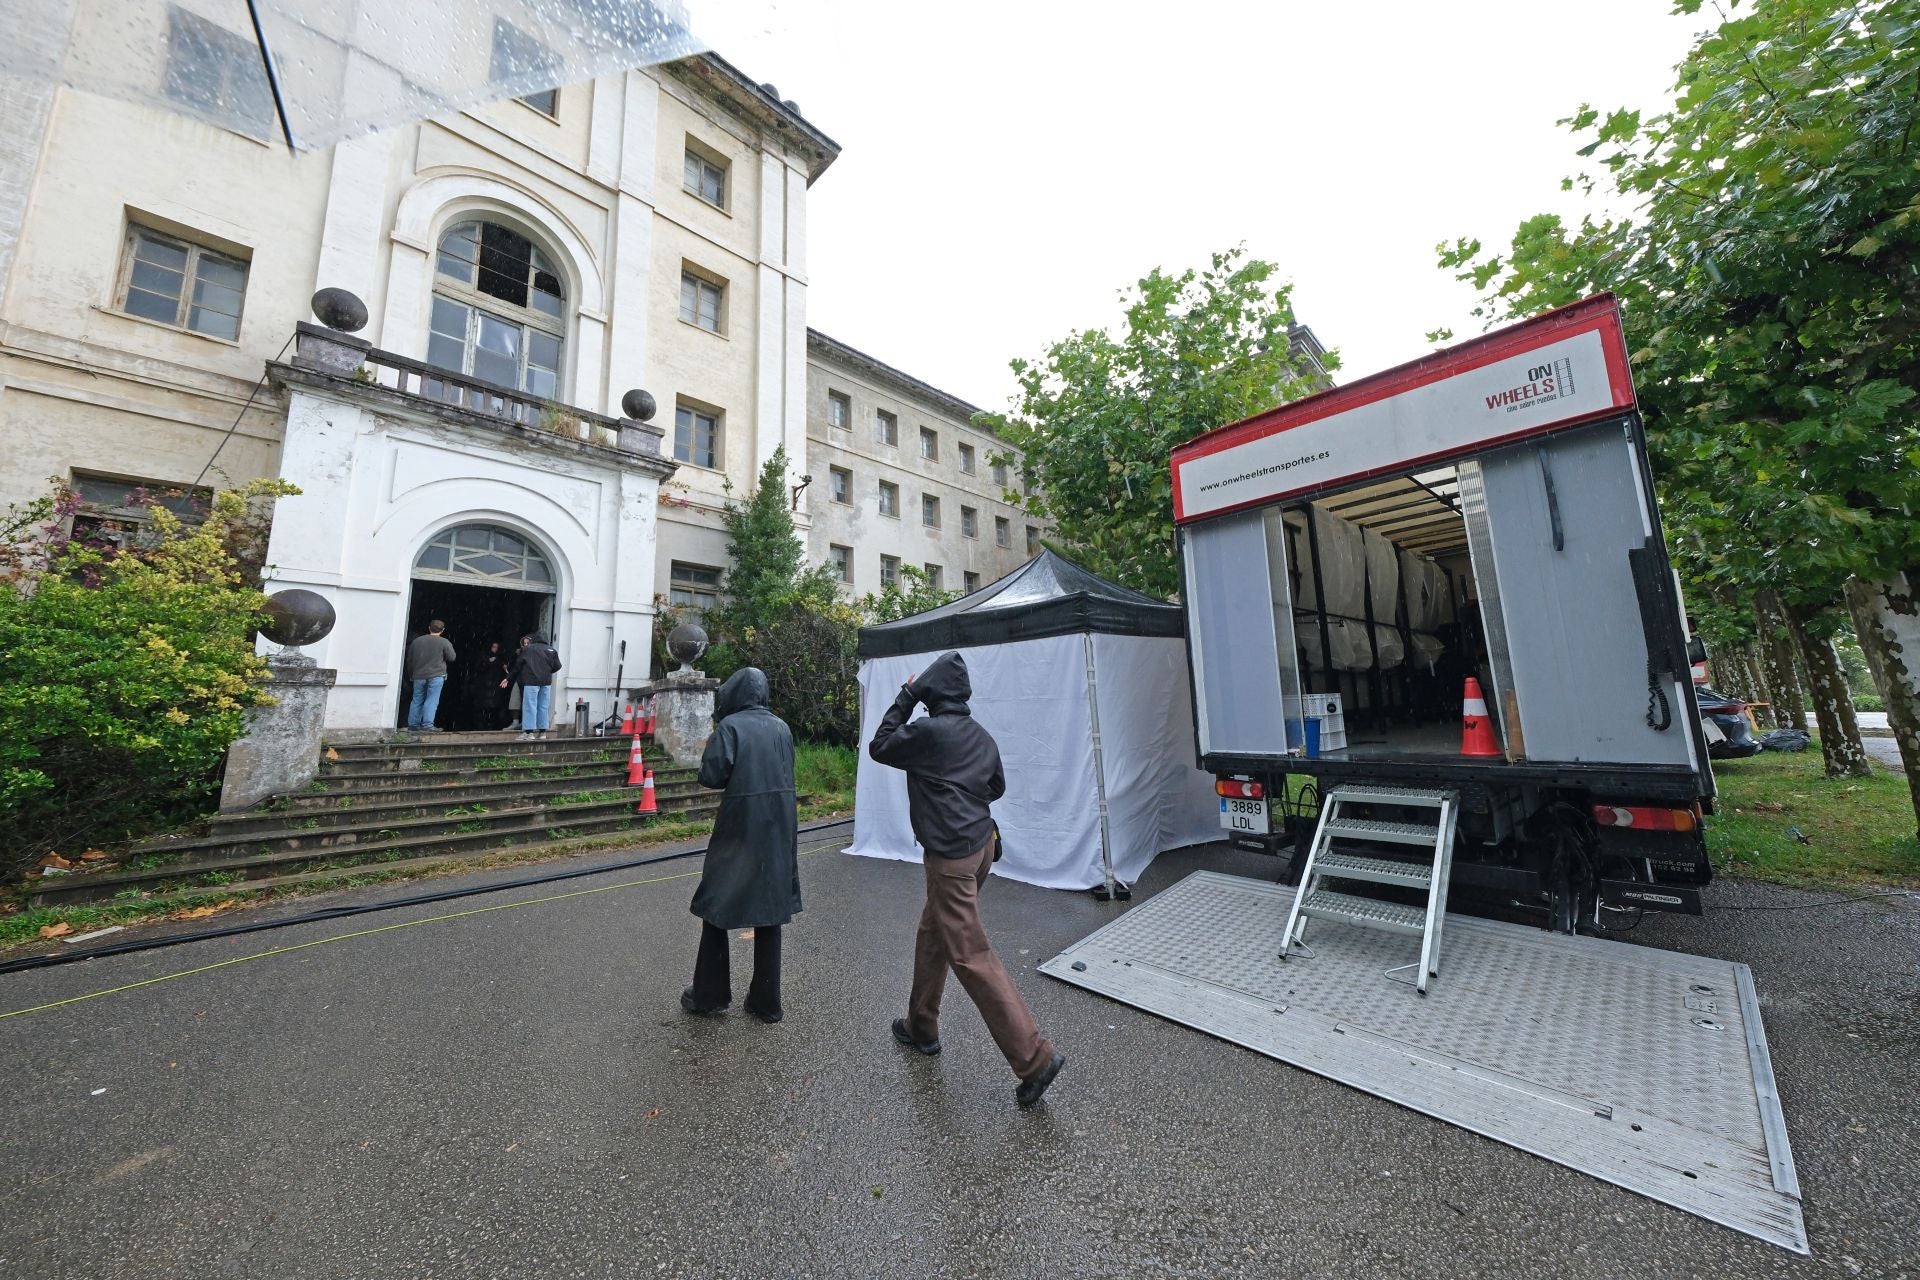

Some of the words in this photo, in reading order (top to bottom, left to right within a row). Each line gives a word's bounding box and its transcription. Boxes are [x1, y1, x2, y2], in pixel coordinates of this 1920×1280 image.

[1527, 363, 1552, 382] ON
[1485, 378, 1555, 410] WHEELS
[1199, 450, 1330, 492] www.onwheelstransportes.es
[1231, 800, 1262, 815] 3889
[1232, 816, 1255, 830] LDL
